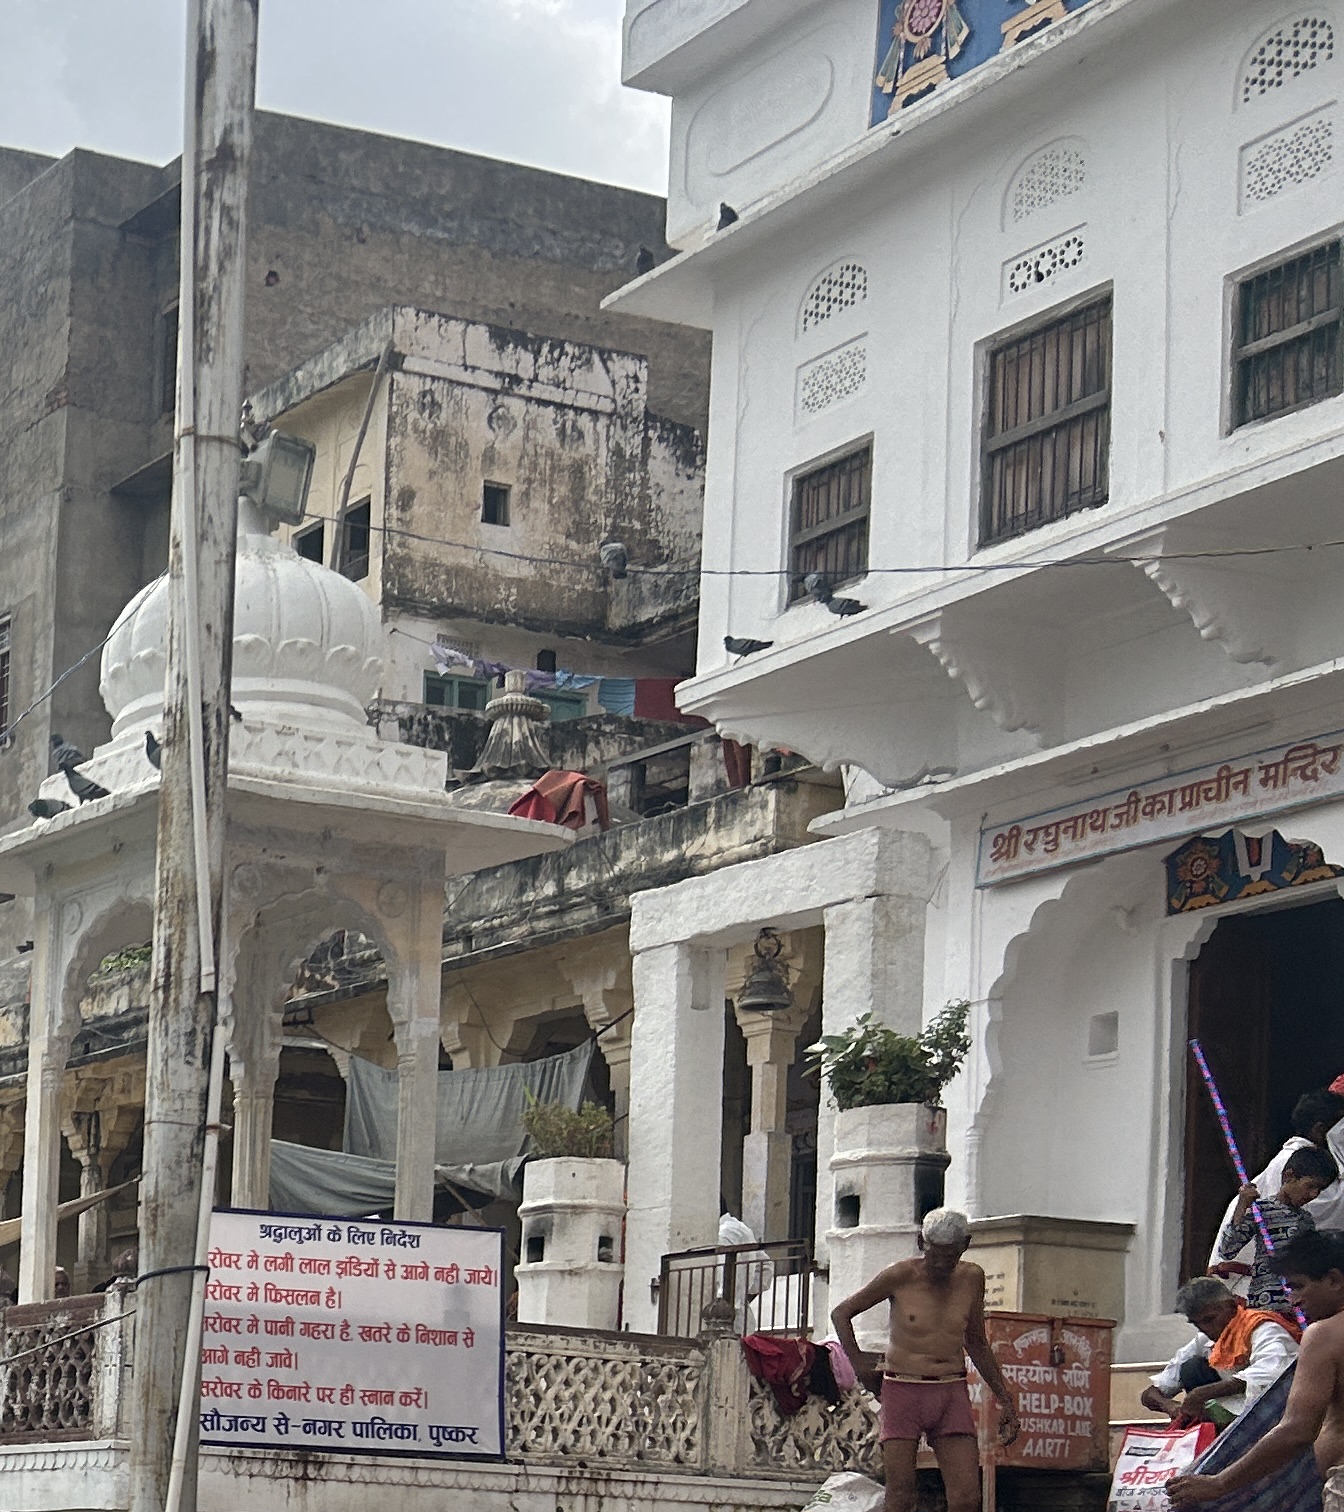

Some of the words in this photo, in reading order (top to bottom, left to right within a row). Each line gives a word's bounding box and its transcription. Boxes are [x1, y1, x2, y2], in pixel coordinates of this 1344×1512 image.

[990, 825, 1022, 863] श्री
[1142, 788, 1178, 816] का
[1179, 765, 1253, 811] प्राचीन
[1258, 743, 1344, 790] मन्दिर
[327, 1225, 342, 1243] के
[347, 1226, 375, 1245] लिए
[380, 1229, 421, 1248] निर्देश
[208, 1247, 243, 1270] रोवर
[264, 1252, 294, 1273] लगी
[299, 1257, 331, 1275] लाल
[336, 1256, 379, 1279] झंडियों
[383, 1258, 397, 1280] से
[401, 1261, 430, 1281] आगे
[206, 1279, 243, 1302] रोवर
[264, 1282, 321, 1307] फिसलन
[263, 1316, 295, 1337] पानी
[300, 1321, 336, 1340] गहरा
[357, 1322, 393, 1343] खतरे
[397, 1323, 411, 1343] के
[415, 1324, 458, 1346] निशान
[462, 1327, 475, 1348] से
[1002, 1360, 1058, 1391] सहयोग
[247, 1378, 263, 1399] के
[267, 1379, 311, 1403] किनारे
[316, 1387, 336, 1404] पर
[340, 1384, 355, 1405] ही
[359, 1389, 395, 1407] स्नान
[1018, 1392, 1095, 1418] HELP-BOX
[200, 1408, 267, 1433] सौजन्य
[428, 1425, 479, 1447] पुष्कर
[1018, 1417, 1064, 1435] USHKAR
[1022, 1438, 1070, 1458] AARTI
